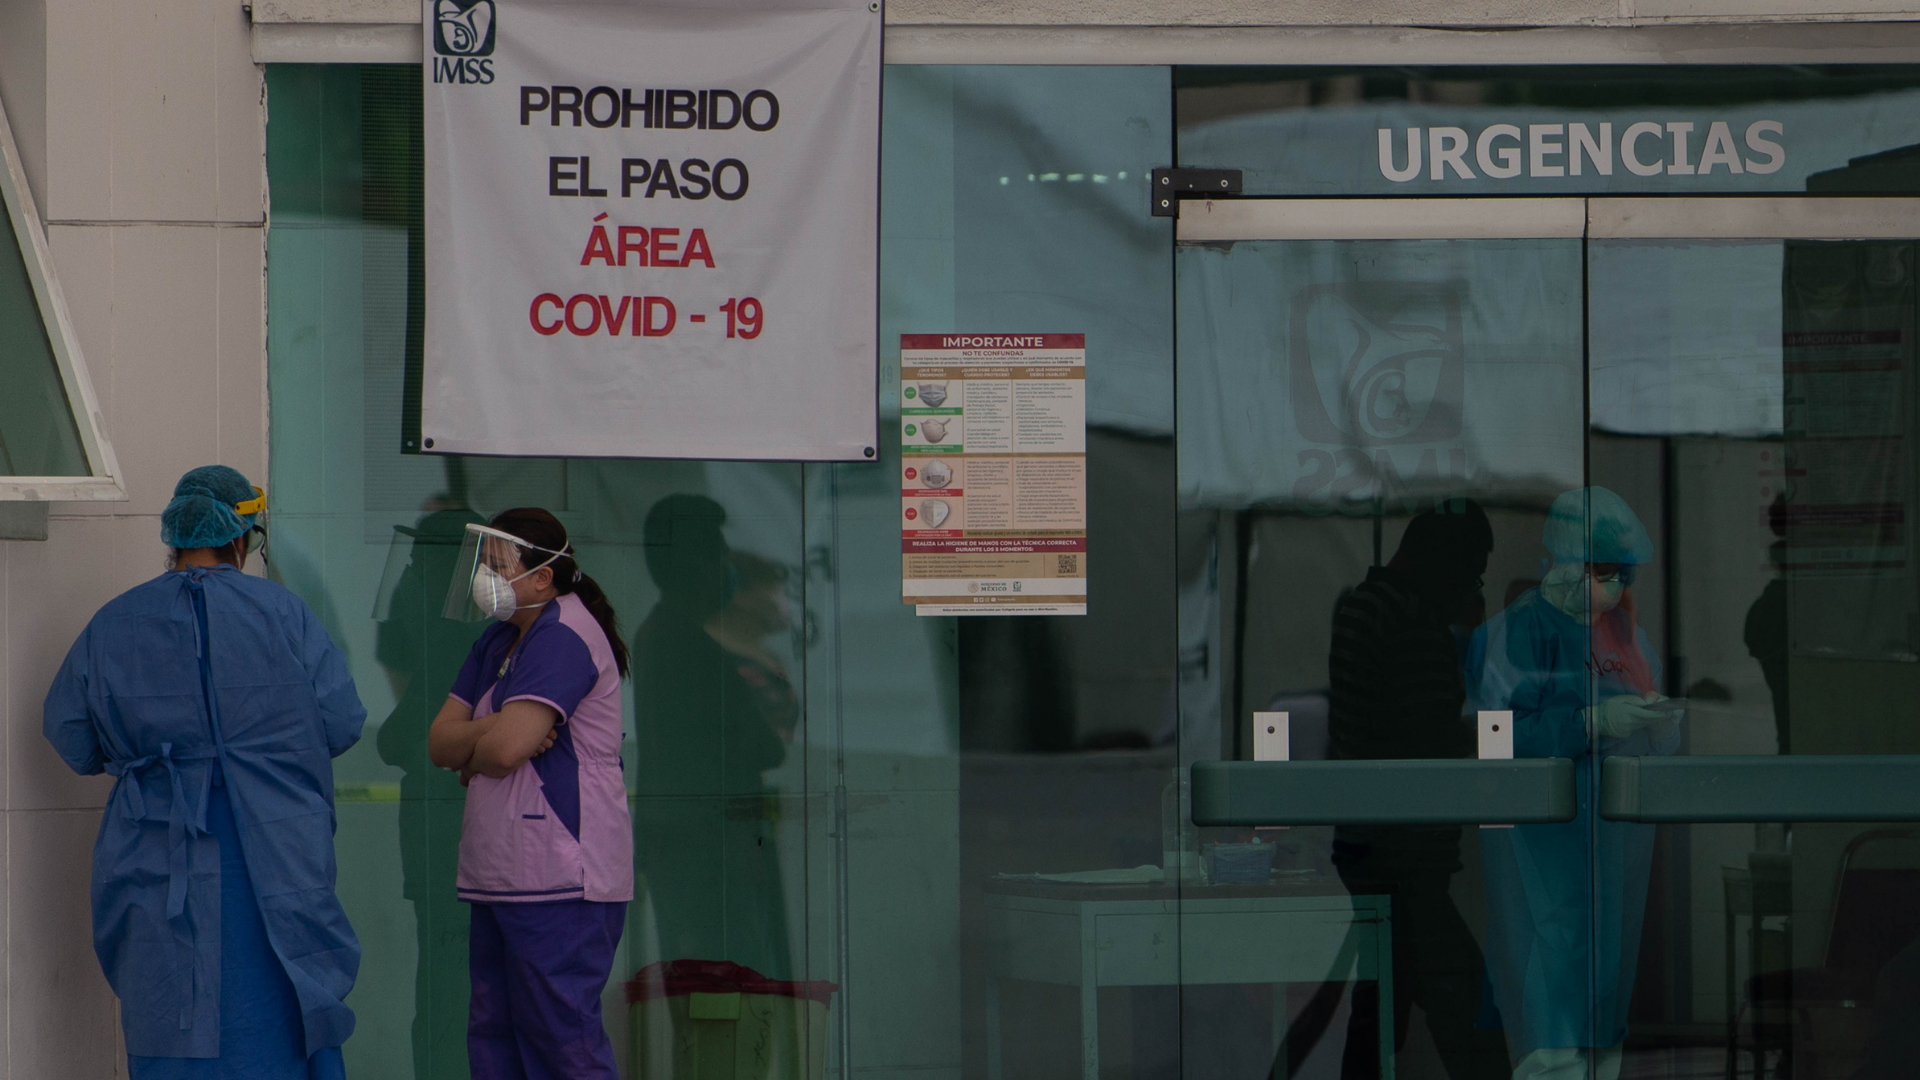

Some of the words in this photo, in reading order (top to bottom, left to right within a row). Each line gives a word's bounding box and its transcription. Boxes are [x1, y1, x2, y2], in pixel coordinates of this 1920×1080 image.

[433, 57, 495, 85] IMSS
[519, 86, 780, 131] PROHIBIDO
[1377, 119, 1786, 182] URGENCIAS
[549, 156, 607, 197] EL
[621, 158, 749, 201] PASO
[580, 212, 716, 269] ÁREA
[529, 293, 677, 337] COVID
[719, 297, 764, 340] 19
[943, 337, 1044, 347] IMPORTANTE
